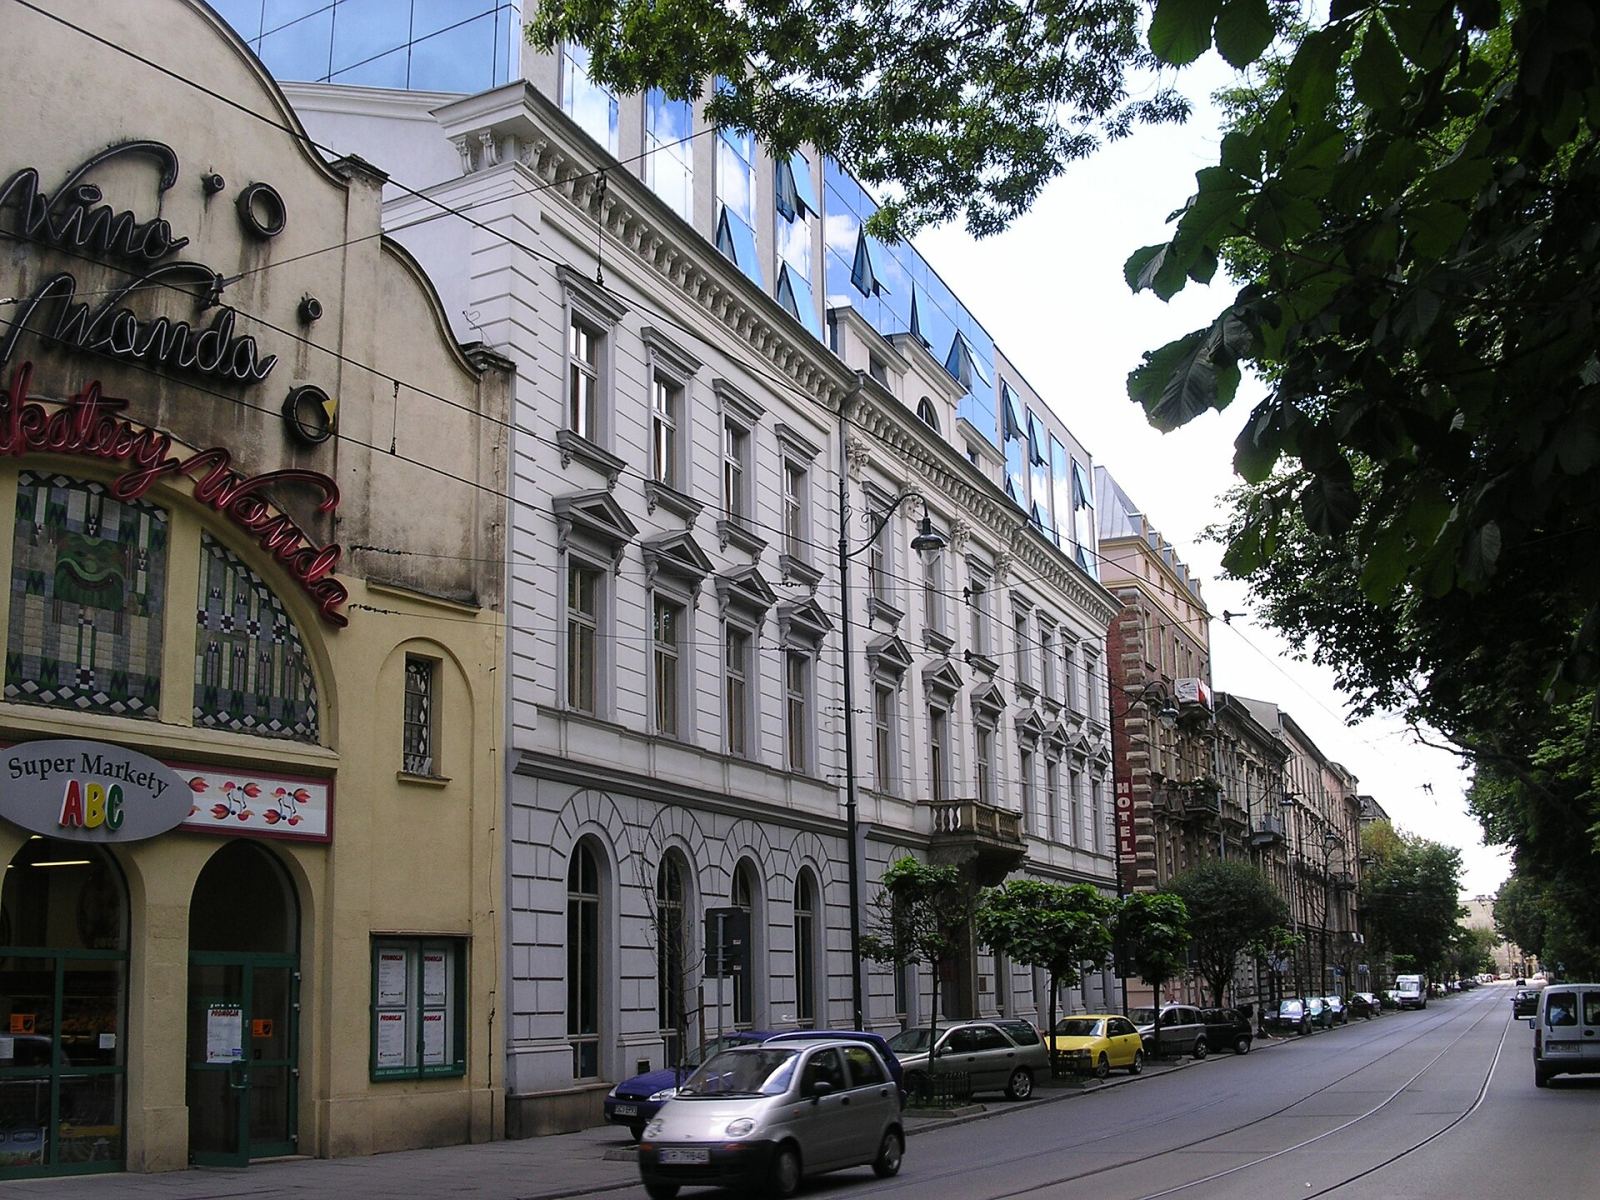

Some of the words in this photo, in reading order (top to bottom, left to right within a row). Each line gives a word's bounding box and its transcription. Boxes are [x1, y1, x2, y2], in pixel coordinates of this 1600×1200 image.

[0, 140, 190, 260] Kino
[0, 262, 278, 382] Wanda
[178, 447, 349, 628] Wanda
[8, 756, 76, 781] Super
[80, 752, 170, 799] Markety
[58, 778, 125, 831] ABC
[1117, 783, 1132, 852] HOTEL
